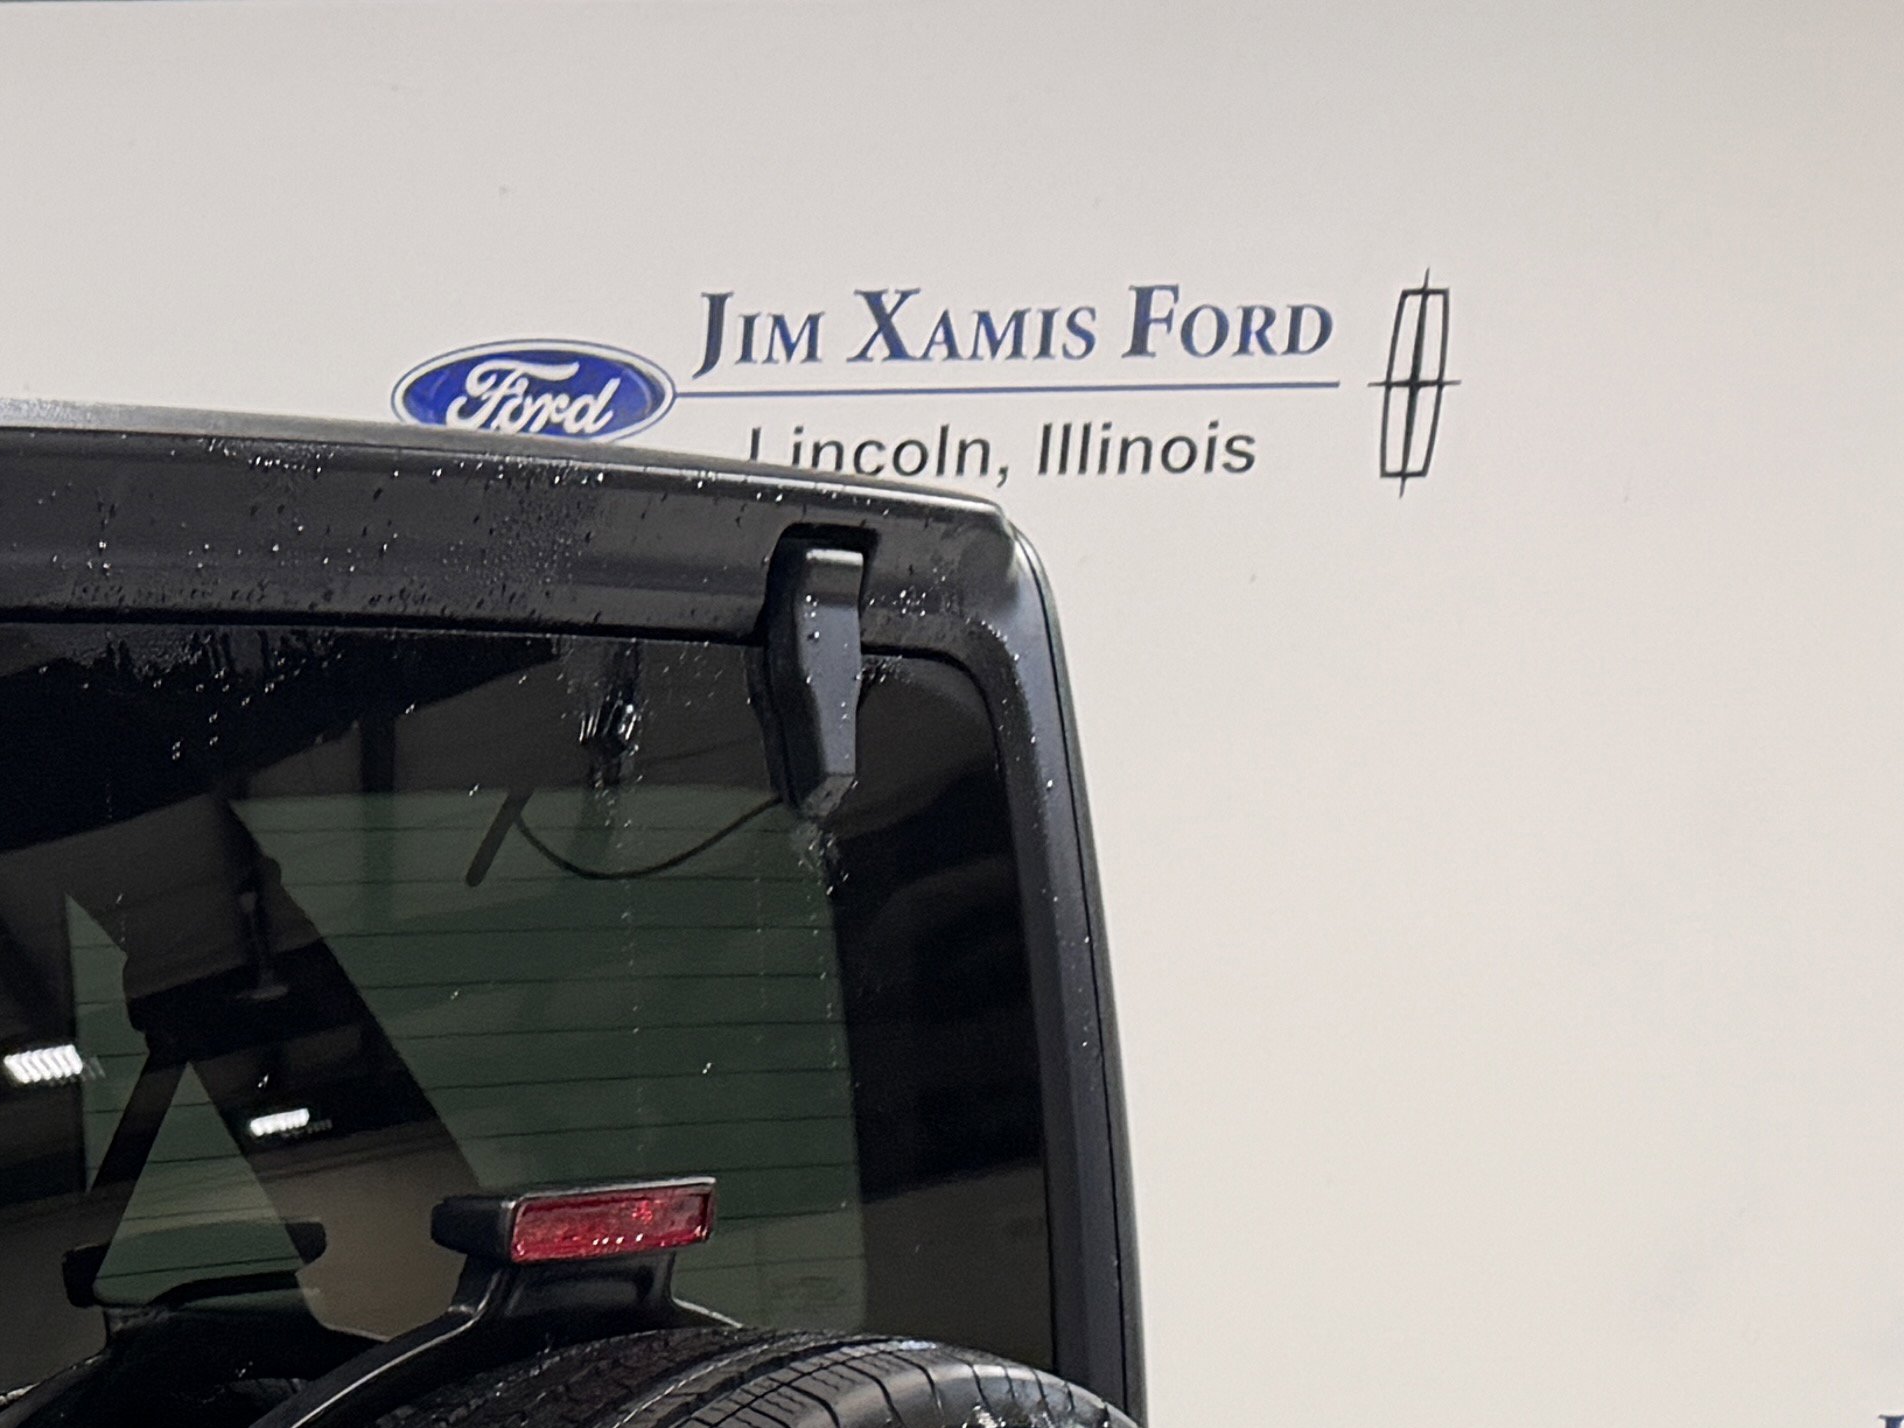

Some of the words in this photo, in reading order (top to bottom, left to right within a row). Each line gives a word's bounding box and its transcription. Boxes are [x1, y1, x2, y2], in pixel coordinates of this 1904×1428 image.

[692, 291, 824, 380] JIM
[846, 285, 1097, 364] XAMIS
[1122, 284, 1334, 360] FORD
[446, 360, 620, 433] Ford
[1036, 420, 1256, 478] Illinois
